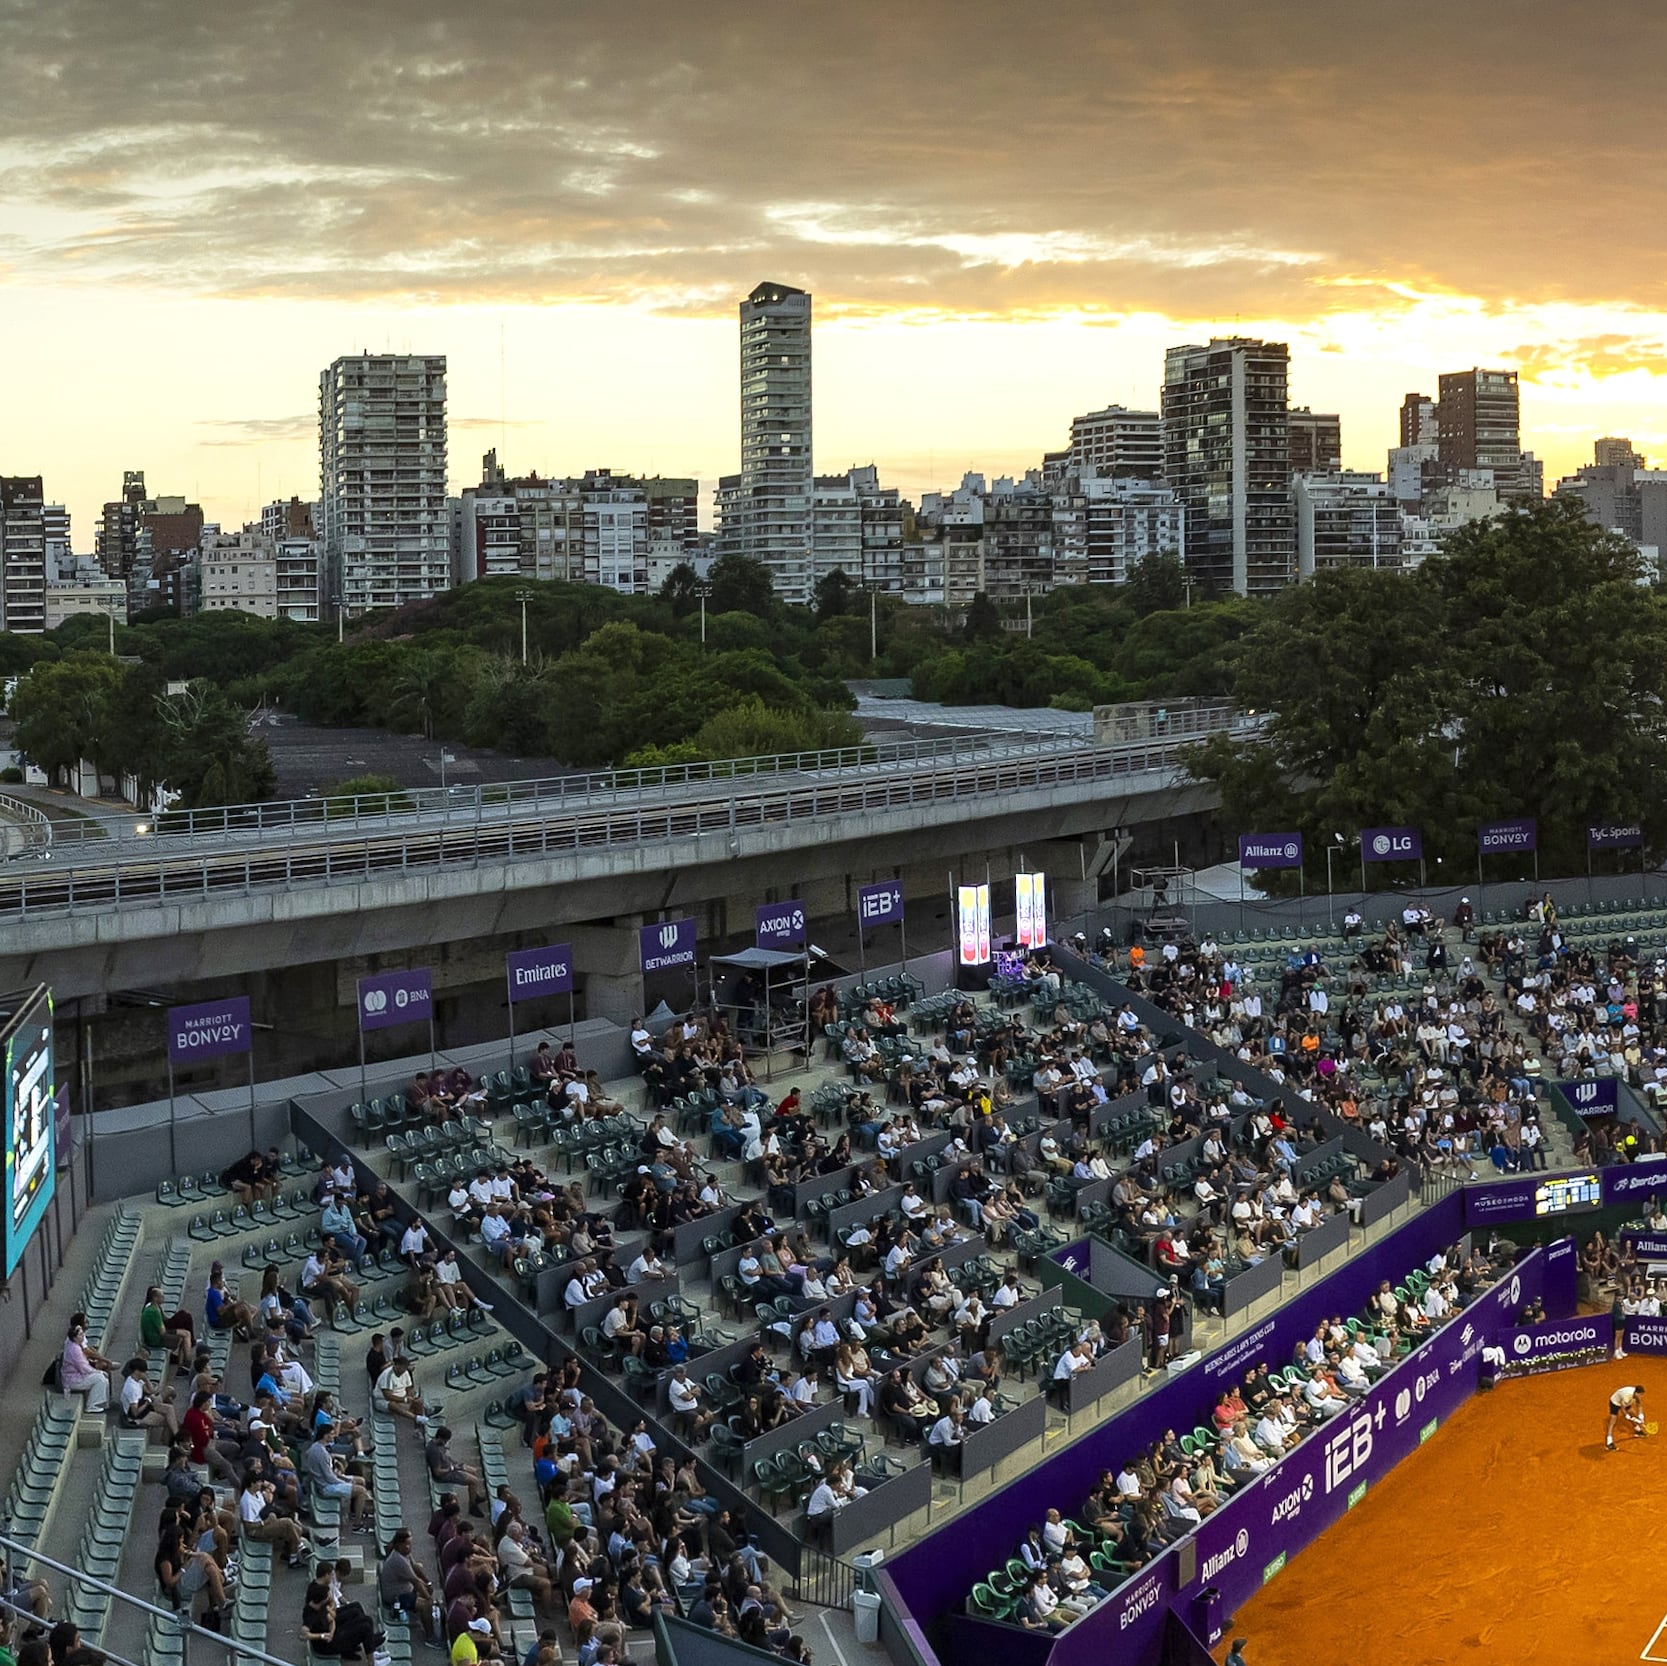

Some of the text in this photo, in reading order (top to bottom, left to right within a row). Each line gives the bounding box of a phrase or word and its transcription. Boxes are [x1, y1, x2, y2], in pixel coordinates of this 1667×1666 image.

[1393, 836, 1411, 850] LG
[1483, 833, 1529, 846] BONVOY
[1245, 842, 1283, 857] Allianz
[759, 916, 790, 934] AXION
[645, 951, 694, 970] BETWARRIOR
[516, 963, 567, 985] Emirates
[410, 989, 429, 1002] BNA
[185, 1013, 233, 1029] MARRIOTT
[177, 1023, 242, 1049] BONVOY
[1575, 1104, 1614, 1117] WARRIOR
[1535, 1327, 1596, 1348] motorola
[1271, 1487, 1301, 1525] AXION
[1201, 1543, 1235, 1585] Allianz
[1125, 1575, 1156, 1606] MARRIOTT
[1120, 1582, 1163, 1631] BONVOY
